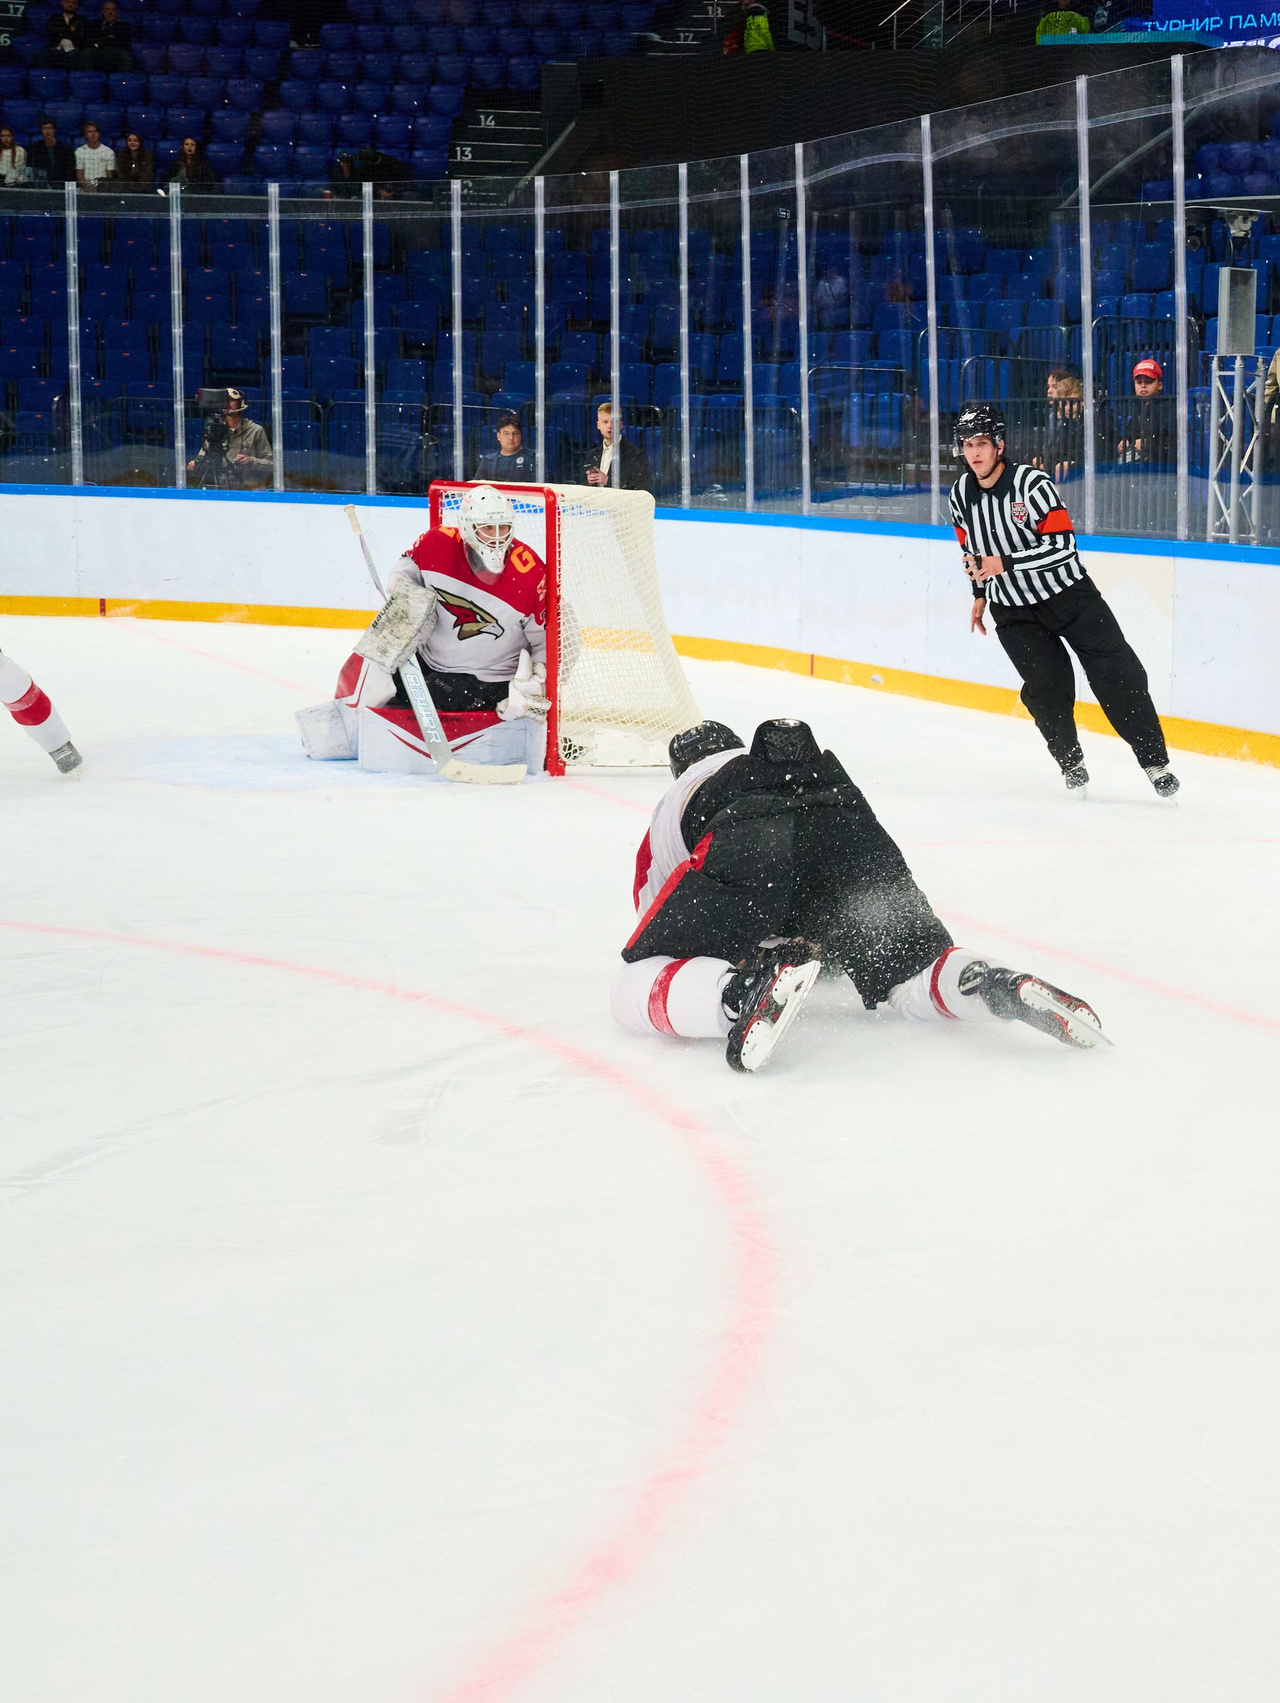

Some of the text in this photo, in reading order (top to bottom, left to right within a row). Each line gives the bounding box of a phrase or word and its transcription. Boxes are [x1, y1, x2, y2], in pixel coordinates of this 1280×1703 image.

[8, 4, 25, 17] 17
[1142, 16, 1223, 32] ТУРНИР
[0, 33, 11, 46] 6
[679, 33, 694, 43] 17
[479, 115, 496, 127] 14
[455, 147, 472, 160] 13
[404, 672, 442, 744] BAUER
